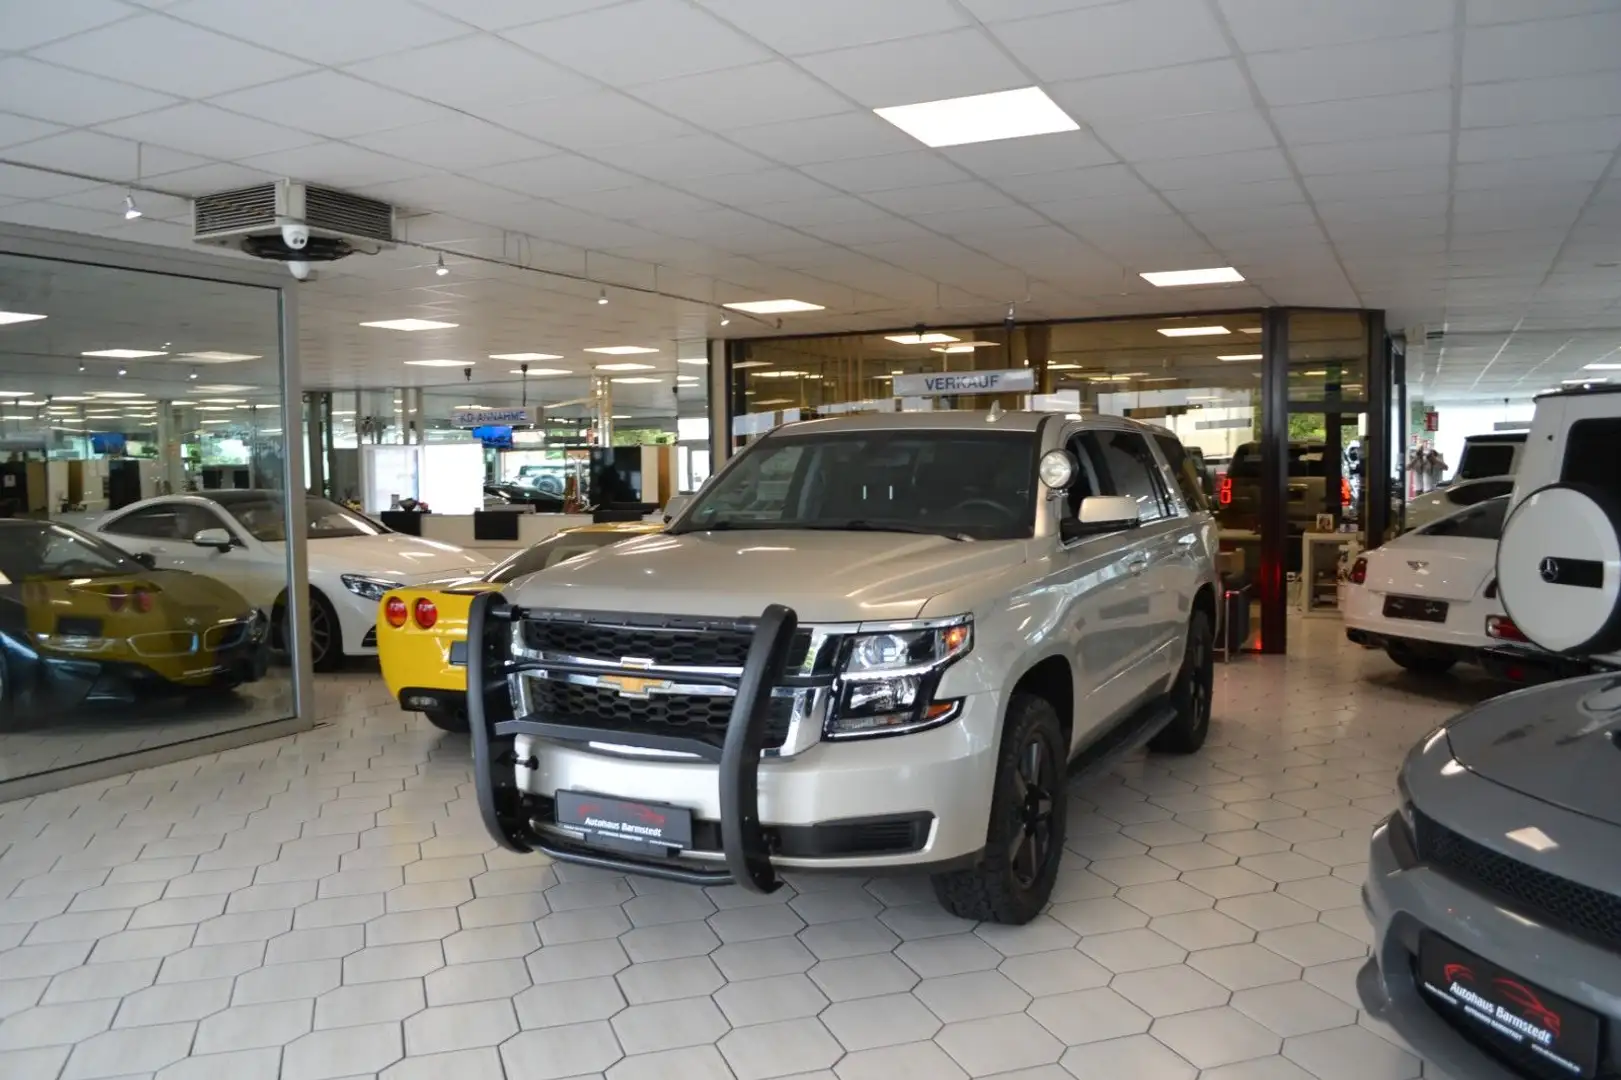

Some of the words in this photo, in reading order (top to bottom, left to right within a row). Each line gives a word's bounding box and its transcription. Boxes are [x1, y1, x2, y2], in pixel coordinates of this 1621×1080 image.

[925, 375, 999, 390] VERKAUF
[585, 817, 620, 830] Autohaus
[621, 823, 662, 837] Barmstedt
[1450, 981, 1494, 1013] Autohaus
[1496, 1006, 1552, 1045] Barmstedt
